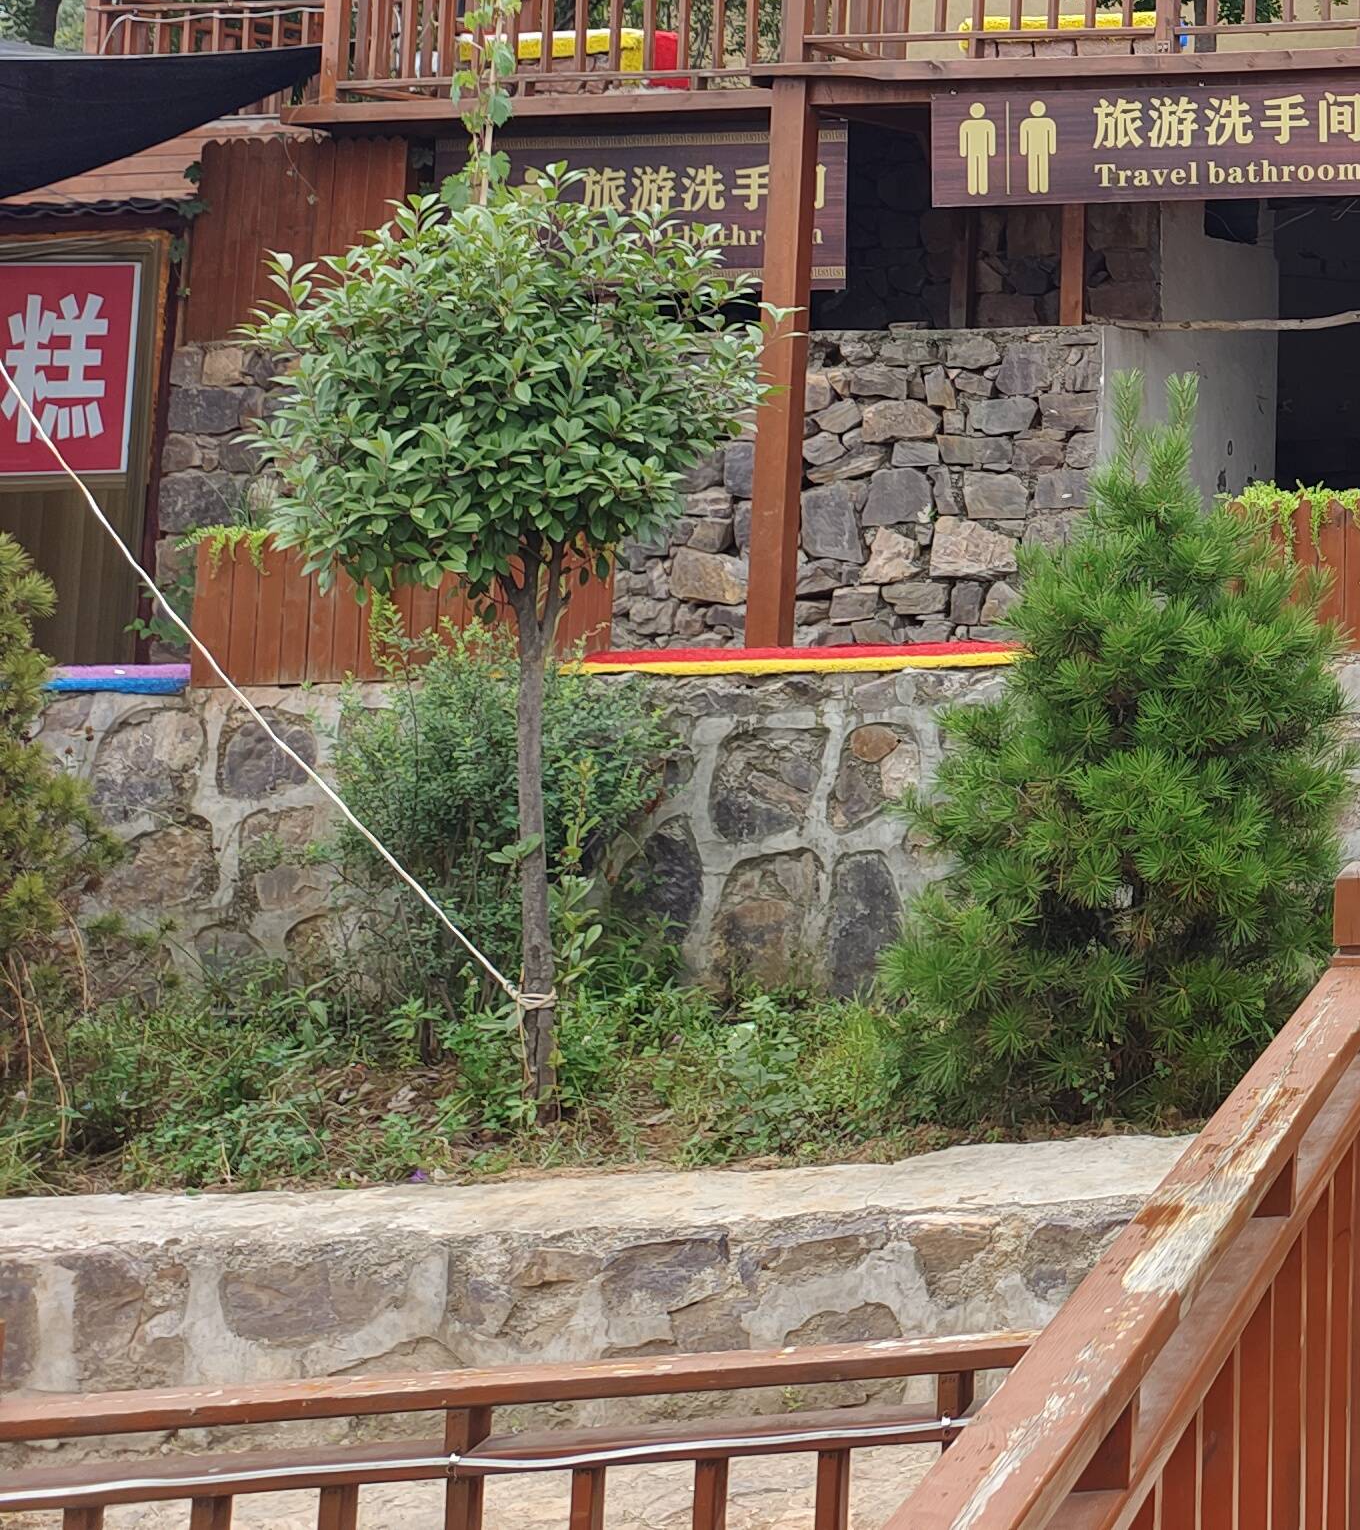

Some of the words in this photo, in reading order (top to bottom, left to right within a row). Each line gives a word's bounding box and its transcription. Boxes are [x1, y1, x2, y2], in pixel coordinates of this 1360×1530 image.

[582, 163, 826, 213] 旅游洗手
[1094, 161, 1200, 188] Travel
[0, 292, 109, 444] 糕
